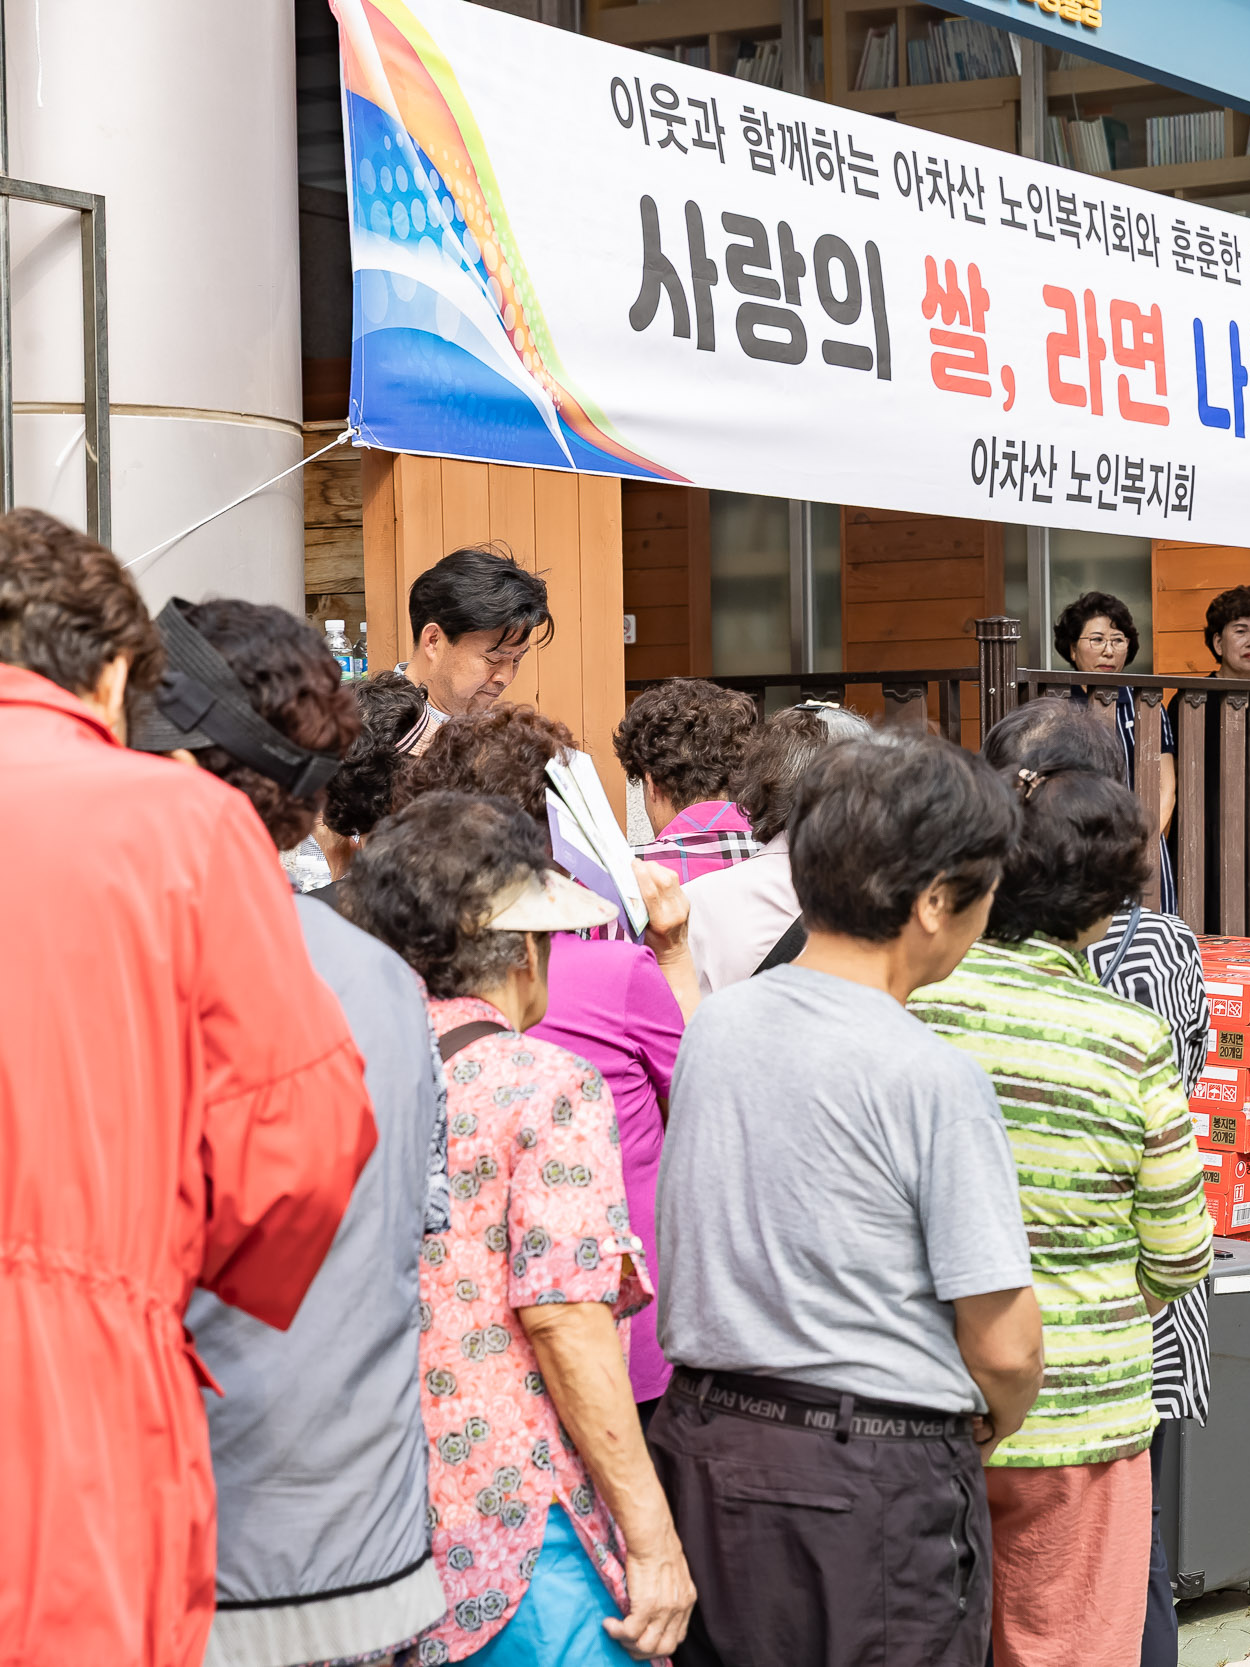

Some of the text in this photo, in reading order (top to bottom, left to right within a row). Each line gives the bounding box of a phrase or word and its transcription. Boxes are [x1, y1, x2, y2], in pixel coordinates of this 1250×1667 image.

[611, 76, 726, 165] 이웃과
[740, 105, 880, 200] 함께하는
[893, 151, 986, 226] 아차산
[998, 176, 1160, 268] 노인복지회와
[1171, 218, 1242, 286] 훈훈한
[628, 194, 892, 382] 사랑의
[921, 255, 1016, 412] 쌀,
[1043, 284, 1170, 426] 라면
[970, 435, 1196, 521] 아차산 노인복지회
[1219, 1046, 1243, 1059] 20개입
[1220, 1032, 1244, 1046] 봉지면
[1212, 1131, 1236, 1144] 20개입
[1213, 1117, 1236, 1131] 봉지면
[739, 1394, 787, 1421] NEPA
[803, 1408, 907, 1437] EVOLUION
